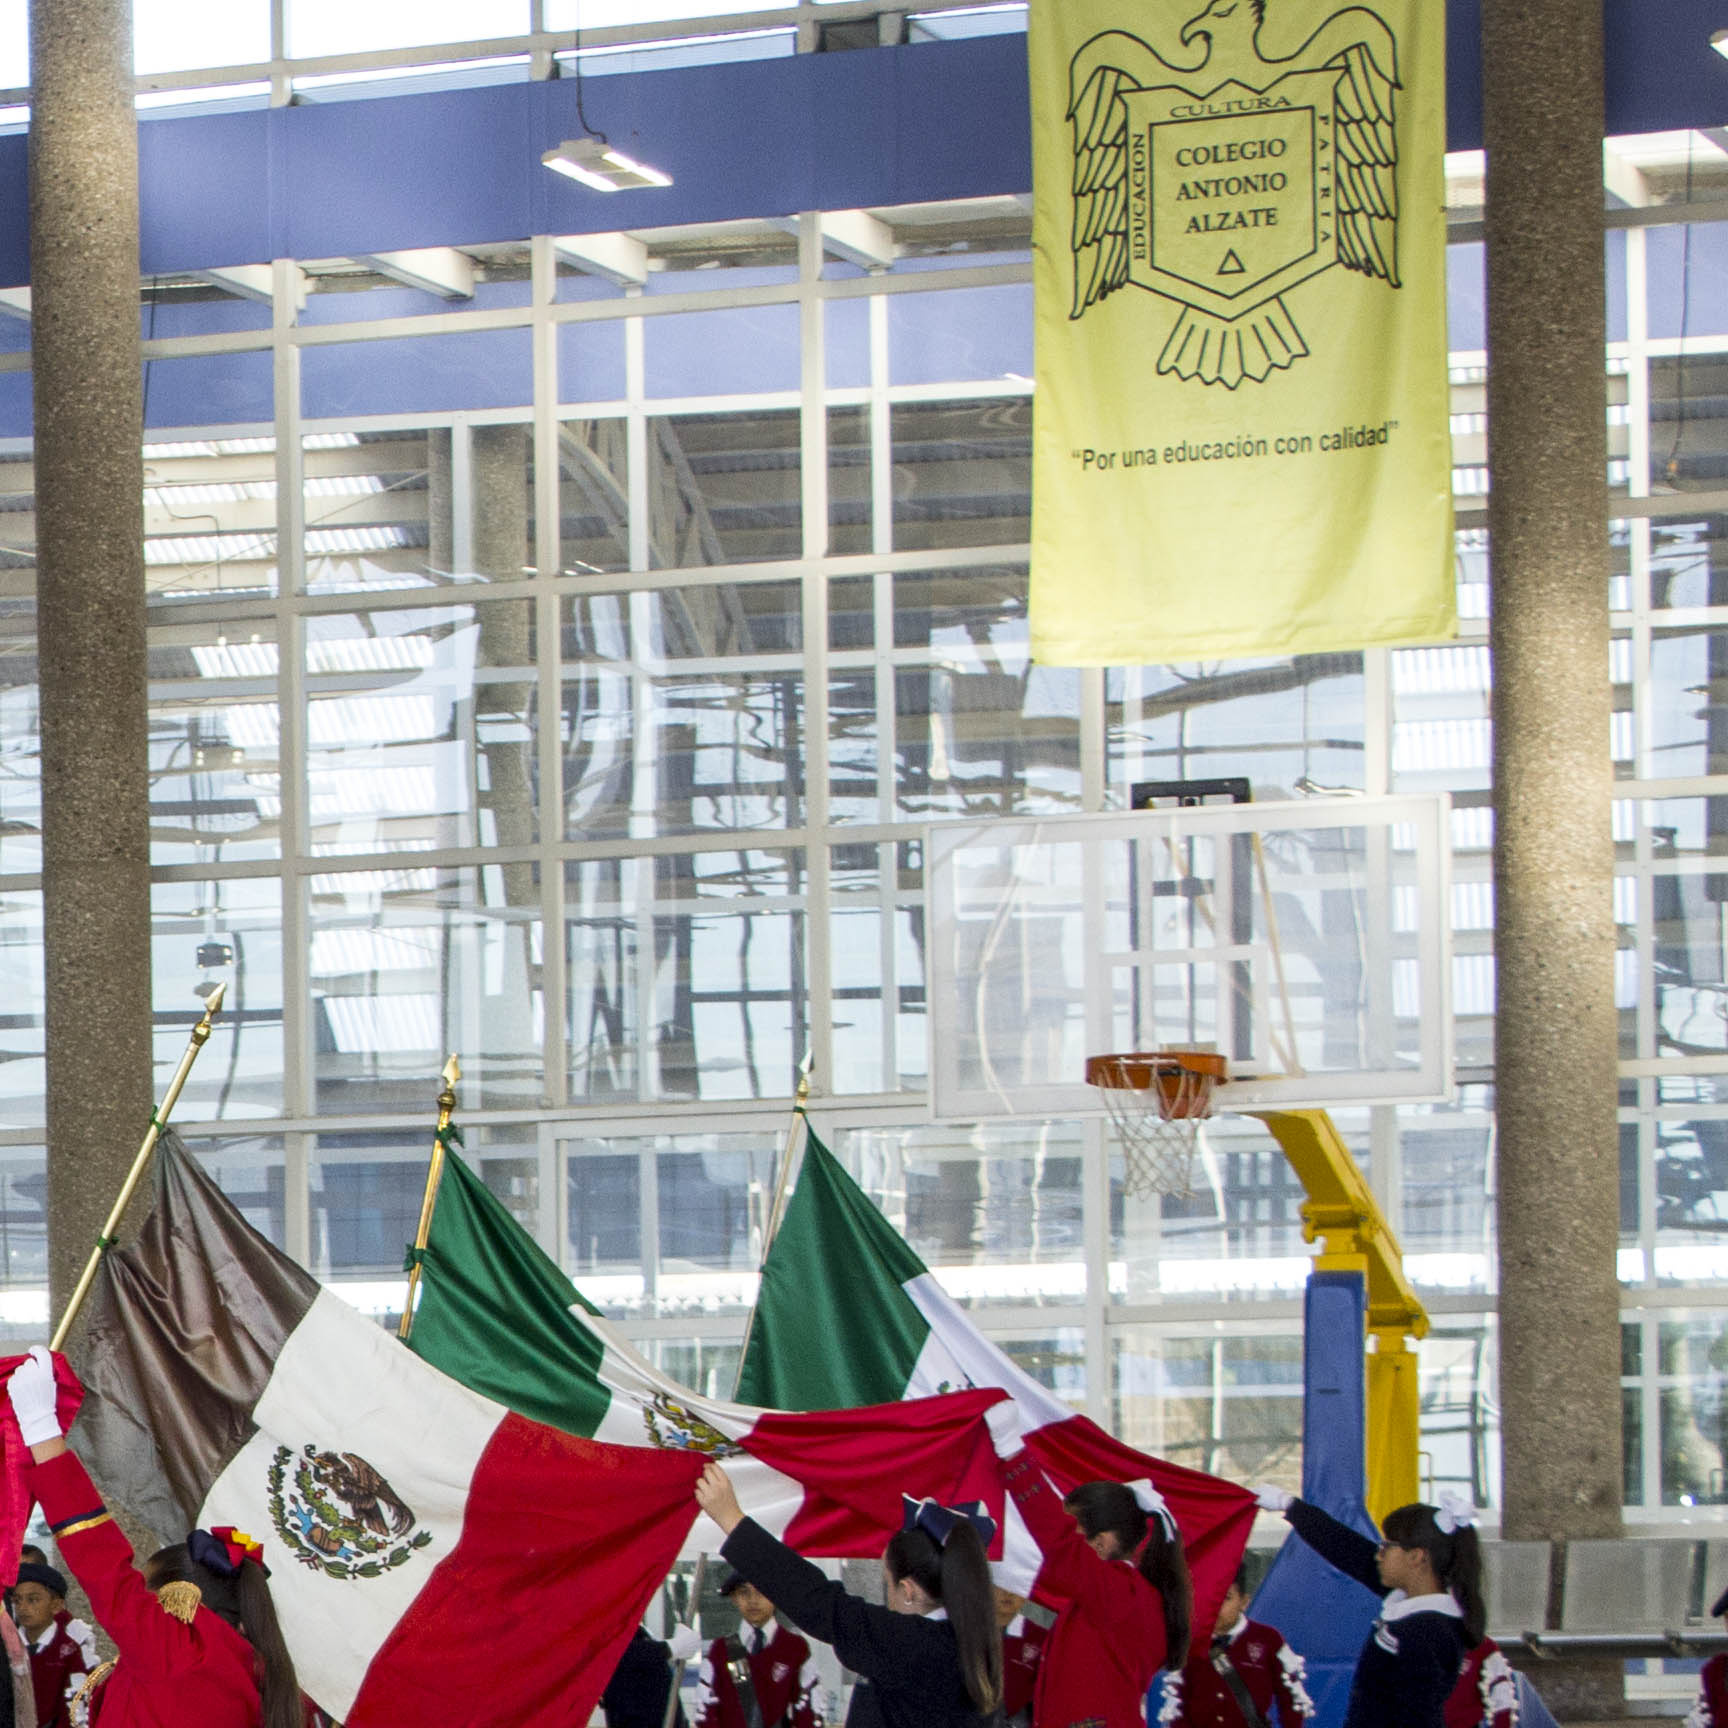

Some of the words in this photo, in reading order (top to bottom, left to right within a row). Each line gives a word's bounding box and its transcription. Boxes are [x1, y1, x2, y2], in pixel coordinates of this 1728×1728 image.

[1170, 96, 1292, 118] CULTURA
[1176, 138, 1286, 167] COLEGIO
[1176, 172, 1286, 201] ANTONIO
[1318, 114, 1332, 243] PATRIA
[1132, 133, 1146, 260] EDUCACION
[1184, 207, 1278, 234] ALZATE
[1122, 448, 1156, 468] una
[1163, 434, 1268, 464] educación
[1274, 435, 1312, 455] con
